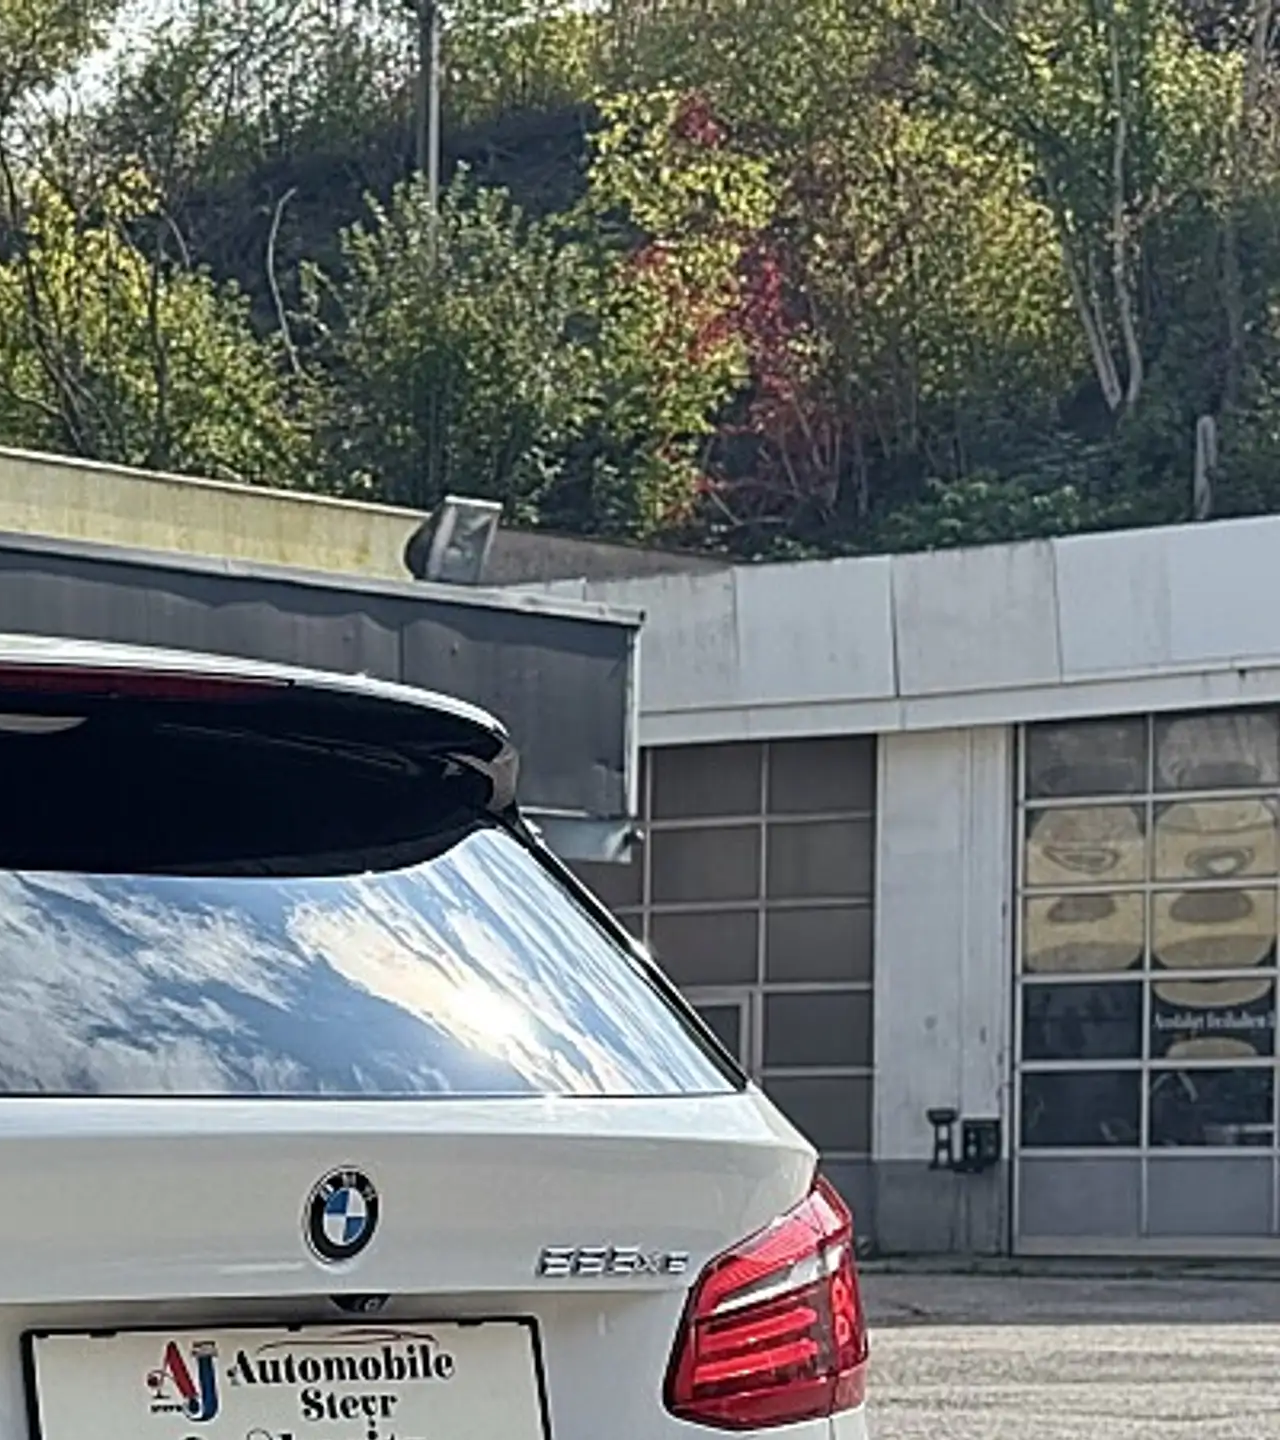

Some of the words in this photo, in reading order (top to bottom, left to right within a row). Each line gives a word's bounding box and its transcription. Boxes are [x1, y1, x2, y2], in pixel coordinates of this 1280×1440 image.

[146, 1340, 220, 1422] AJ
[225, 1343, 455, 1387] Automobile
[299, 1386, 398, 1426] Steyr
